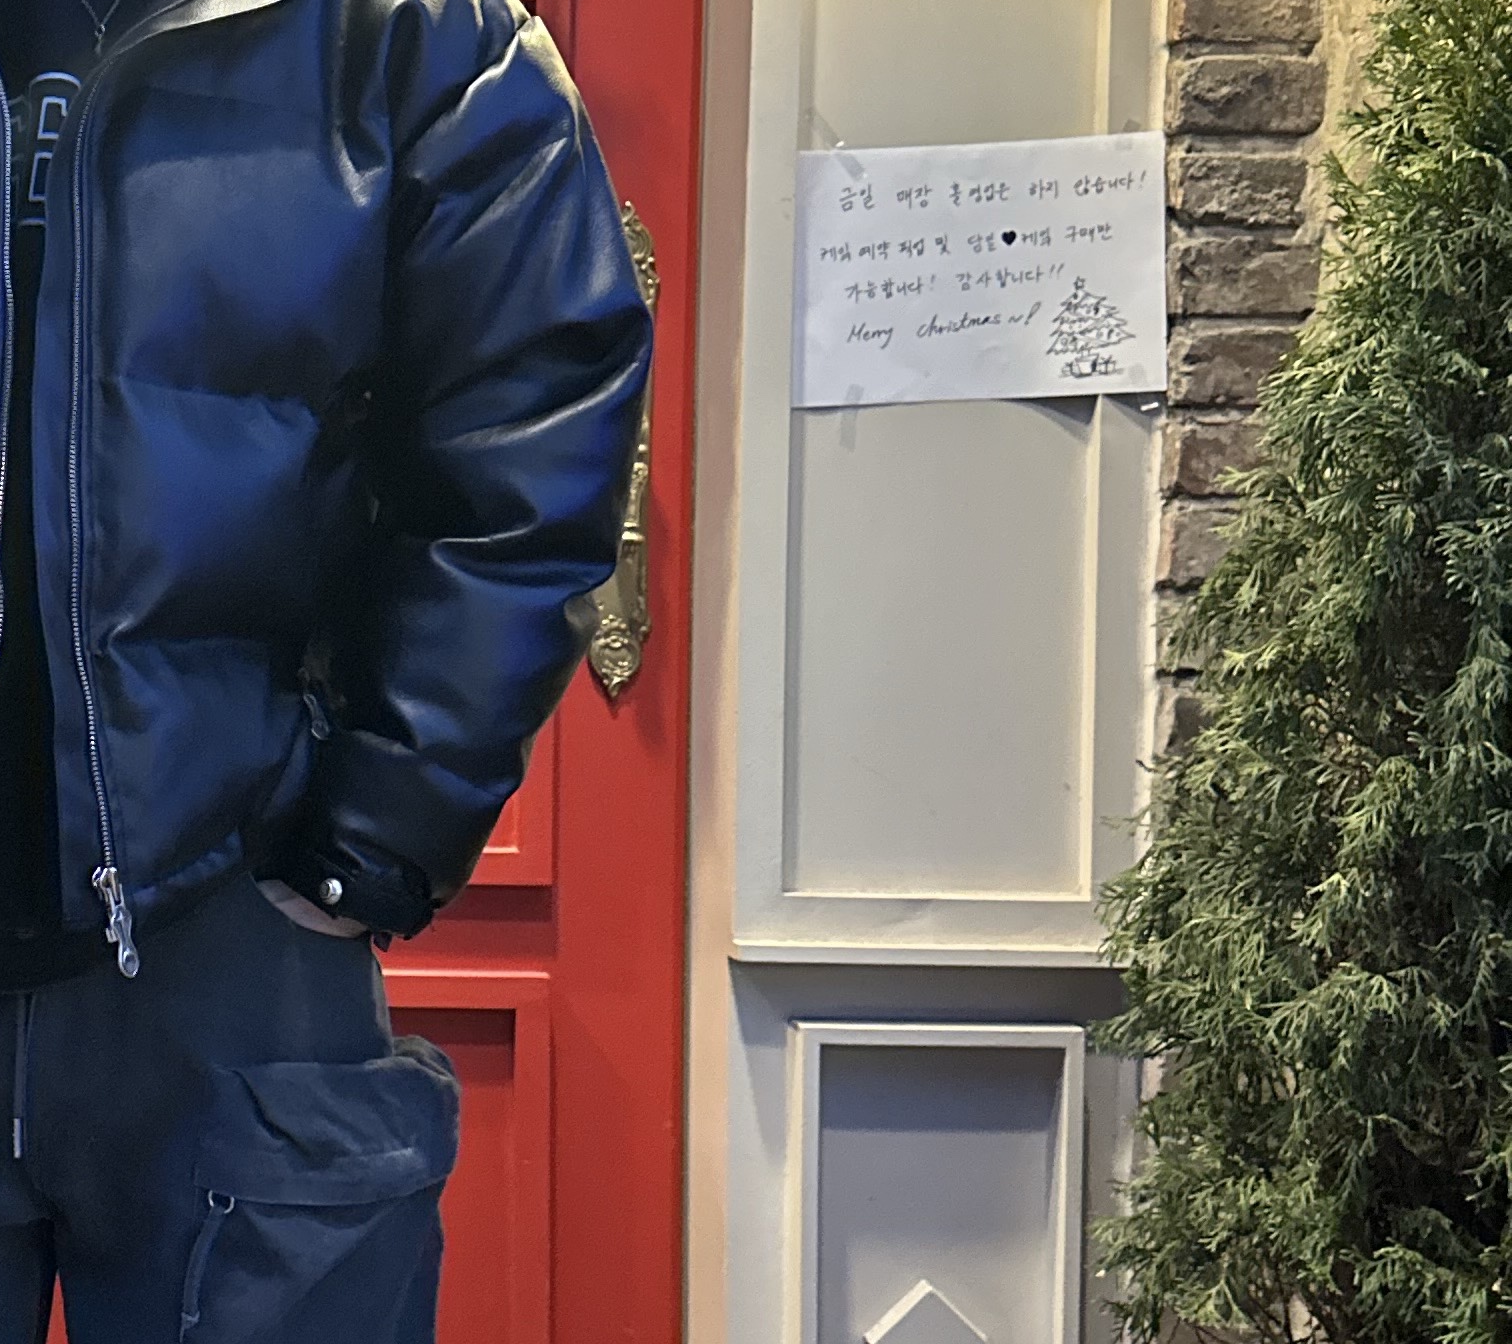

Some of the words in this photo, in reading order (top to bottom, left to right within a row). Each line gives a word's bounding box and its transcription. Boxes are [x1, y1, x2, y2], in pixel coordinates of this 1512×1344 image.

[838, 183, 876, 211] 금일
[896, 186, 933, 209] 매장
[1029, 179, 1059, 200] 하지
[859, 240, 891, 261] 예약
[934, 232, 951, 256] 및
[1064, 222, 1113, 243] 구매만
[844, 274, 936, 304] 가능합니다!
[846, 322, 894, 350] Merry
